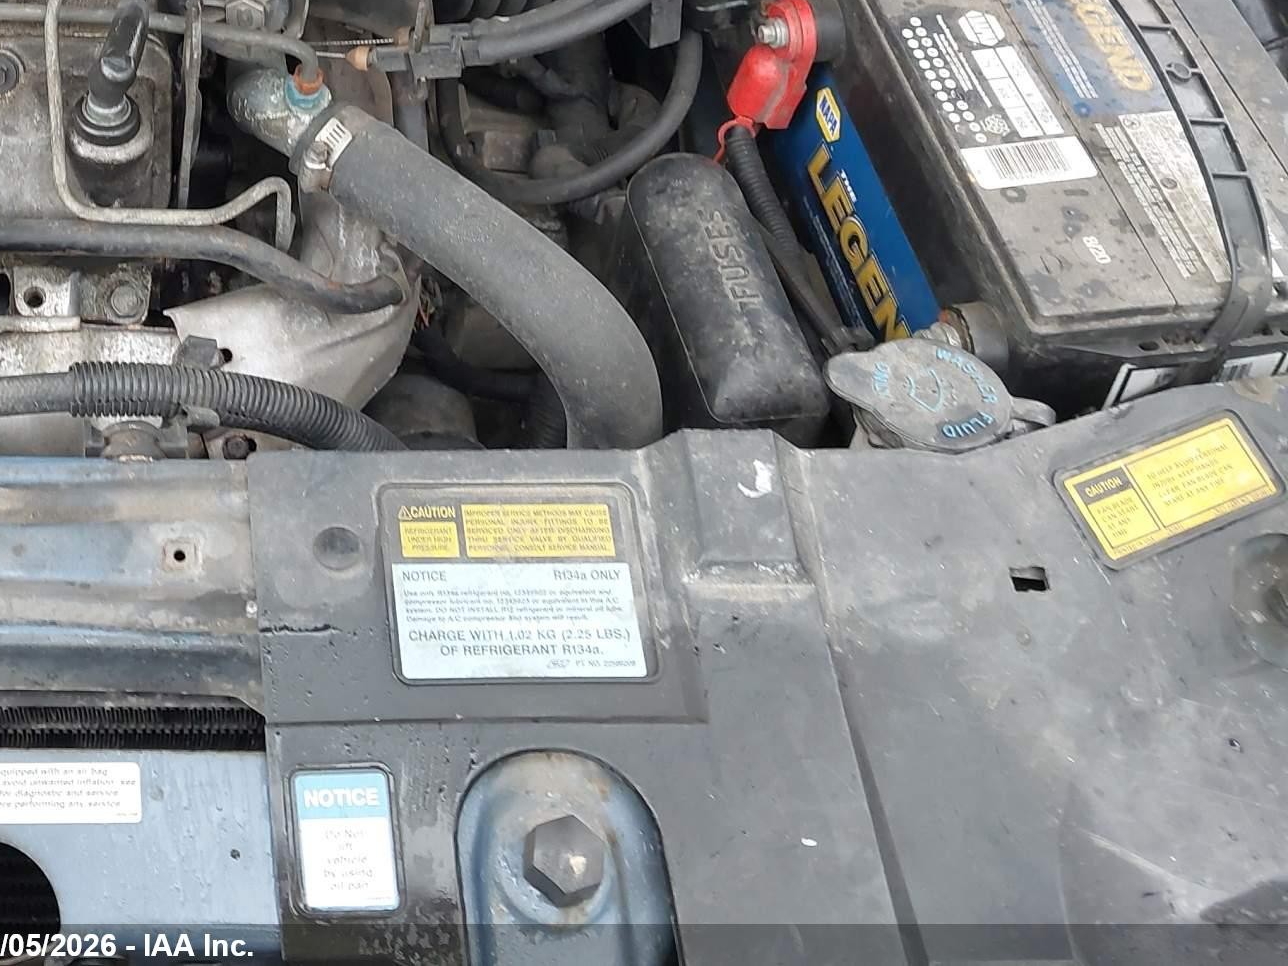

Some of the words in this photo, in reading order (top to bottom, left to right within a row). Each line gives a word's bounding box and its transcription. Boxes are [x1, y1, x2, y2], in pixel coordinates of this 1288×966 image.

[818, 96, 838, 133] NAPA
[840, 168, 858, 203] THE
[808, 138, 913, 343] LEGEN
[1081, 235, 1111, 265] 8/20
[696, 208, 761, 309] FUSES
[936, 347, 998, 404] WASHER
[942, 411, 993, 438] FLUID
[1085, 476, 1123, 498] CAUTION
[410, 505, 456, 519] CAUTION
[402, 570, 448, 582] NOTICE
[553, 569, 588, 581] R134a
[590, 569, 622, 580] ONLY
[409, 628, 464, 642] CHARGE
[470, 628, 504, 641] WITH
[509, 628, 533, 641] 1.02
[537, 628, 557, 641] KG
[562, 628, 592, 642] (2.25
[597, 628, 631, 642] LBS.)
[440, 645, 459, 656] OF
[463, 644, 558, 656] REFRIGERANT
[563, 644, 604, 655] R134a.
[40, 767, 60, 777] with
[63, 767, 75, 777] an
[78, 767, 88, 777] air
[91, 767, 108, 777] bag
[120, 778, 136, 787] see
[0, 789, 12, 797] for
[16, 789, 63, 797] diagnostic
[66, 789, 84, 797] and
[87, 789, 119, 797] service
[303, 787, 381, 808] NOTICE
[15, 799, 65, 809] performing
[69, 799, 84, 809] any
[88, 799, 120, 809] service
[326, 855, 368, 865] vehicle
[341, 869, 374, 879] using
[330, 881, 344, 891] oil
[347, 881, 370, 892] pan
